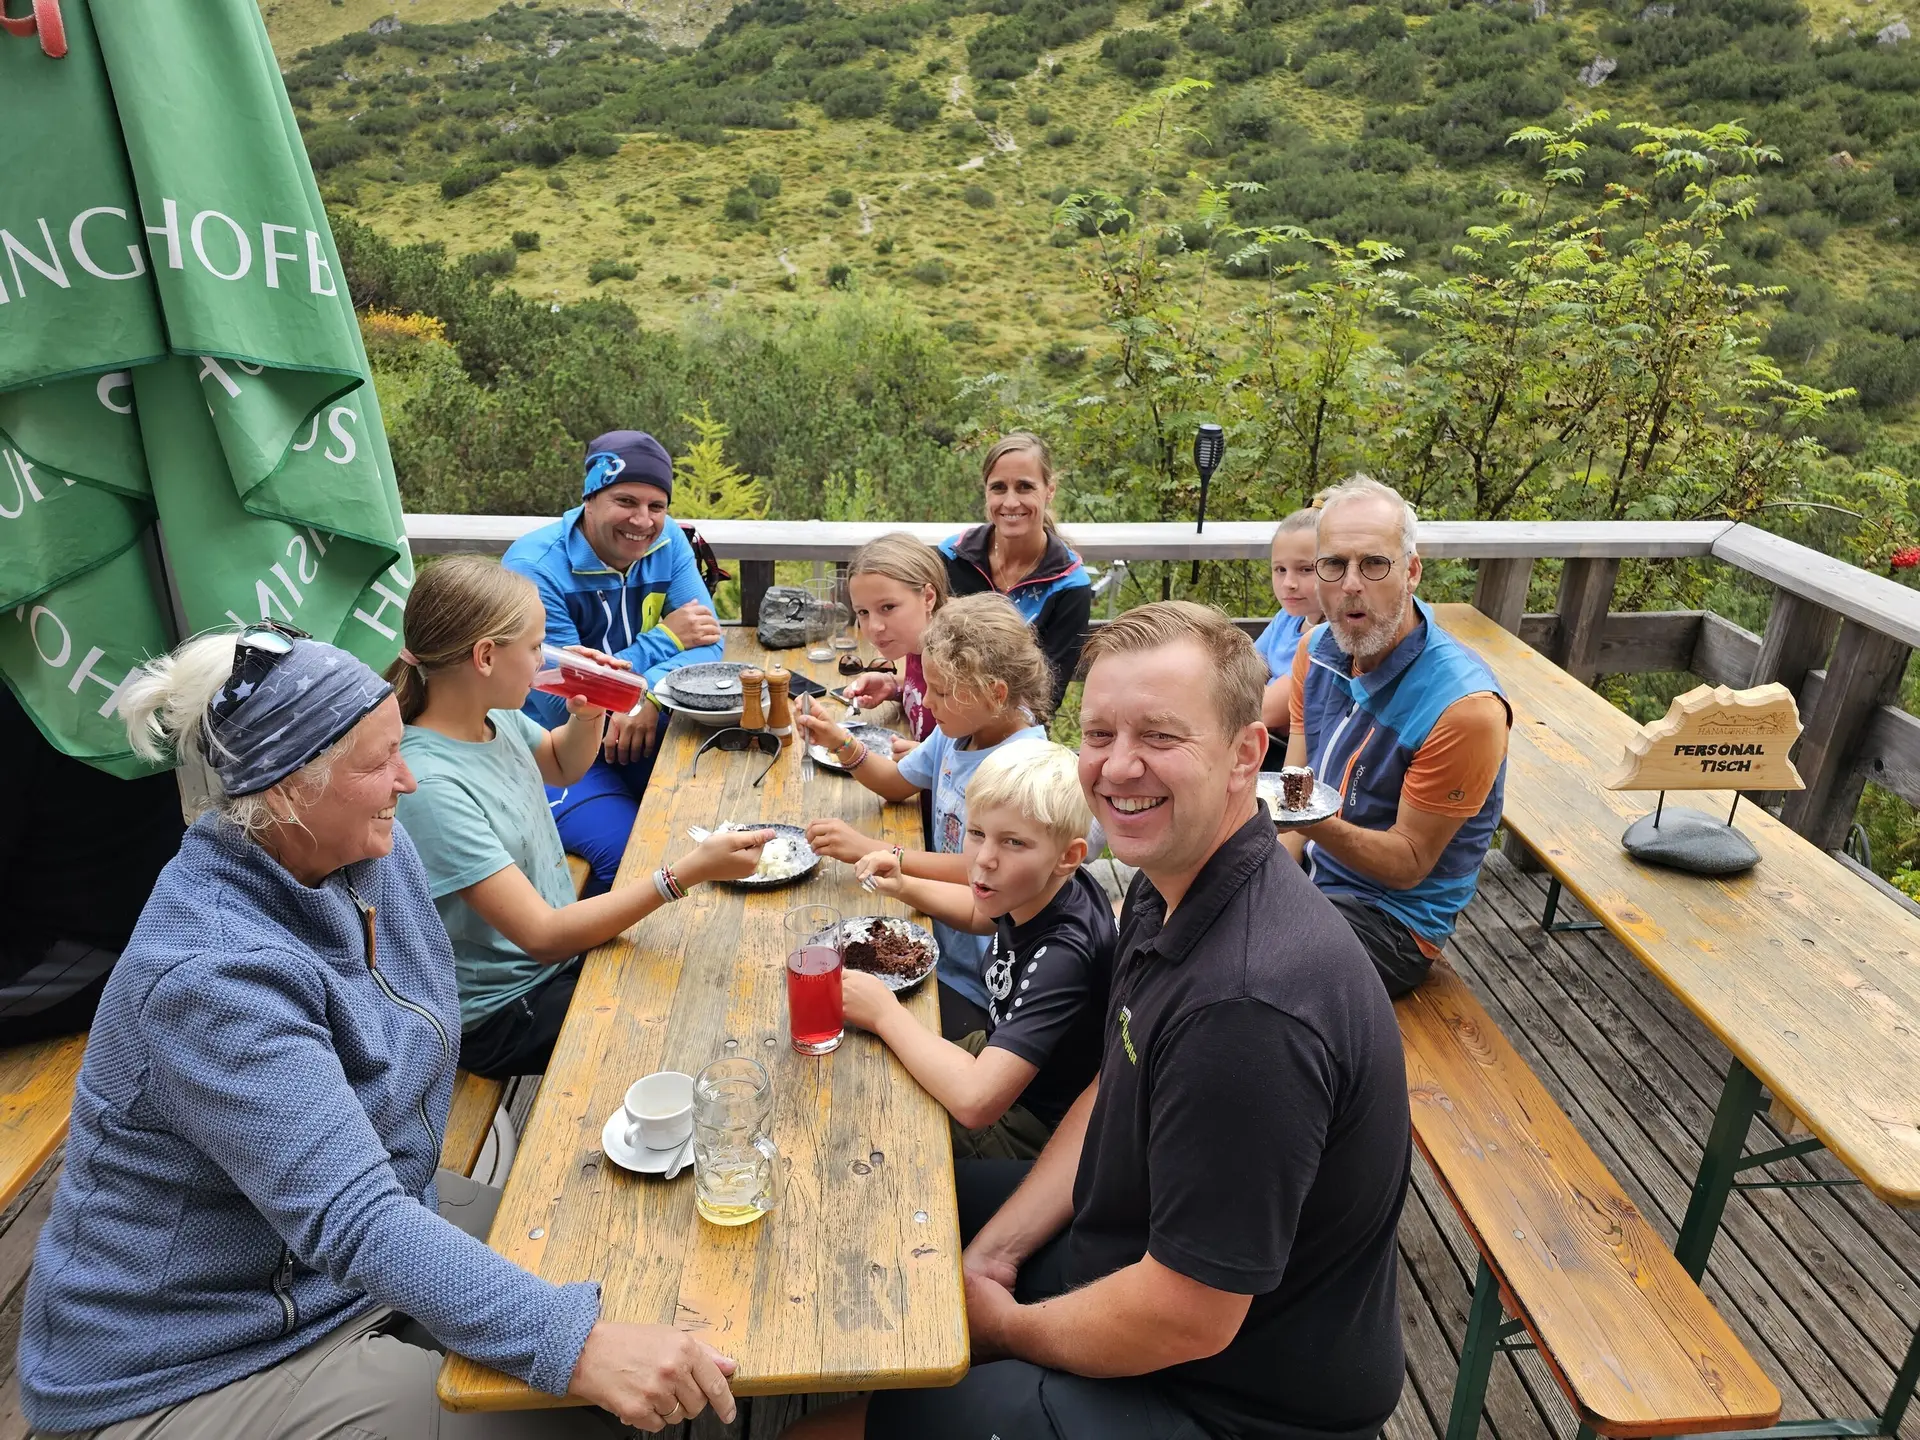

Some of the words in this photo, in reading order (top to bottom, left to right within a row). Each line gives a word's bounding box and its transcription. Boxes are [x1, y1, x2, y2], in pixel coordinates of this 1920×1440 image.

[785, 597, 804, 622] 2
[1674, 744, 1764, 756] PERSONAL
[1701, 760, 1751, 772] TISCH
[1350, 765, 1366, 806] ORTOVOX
